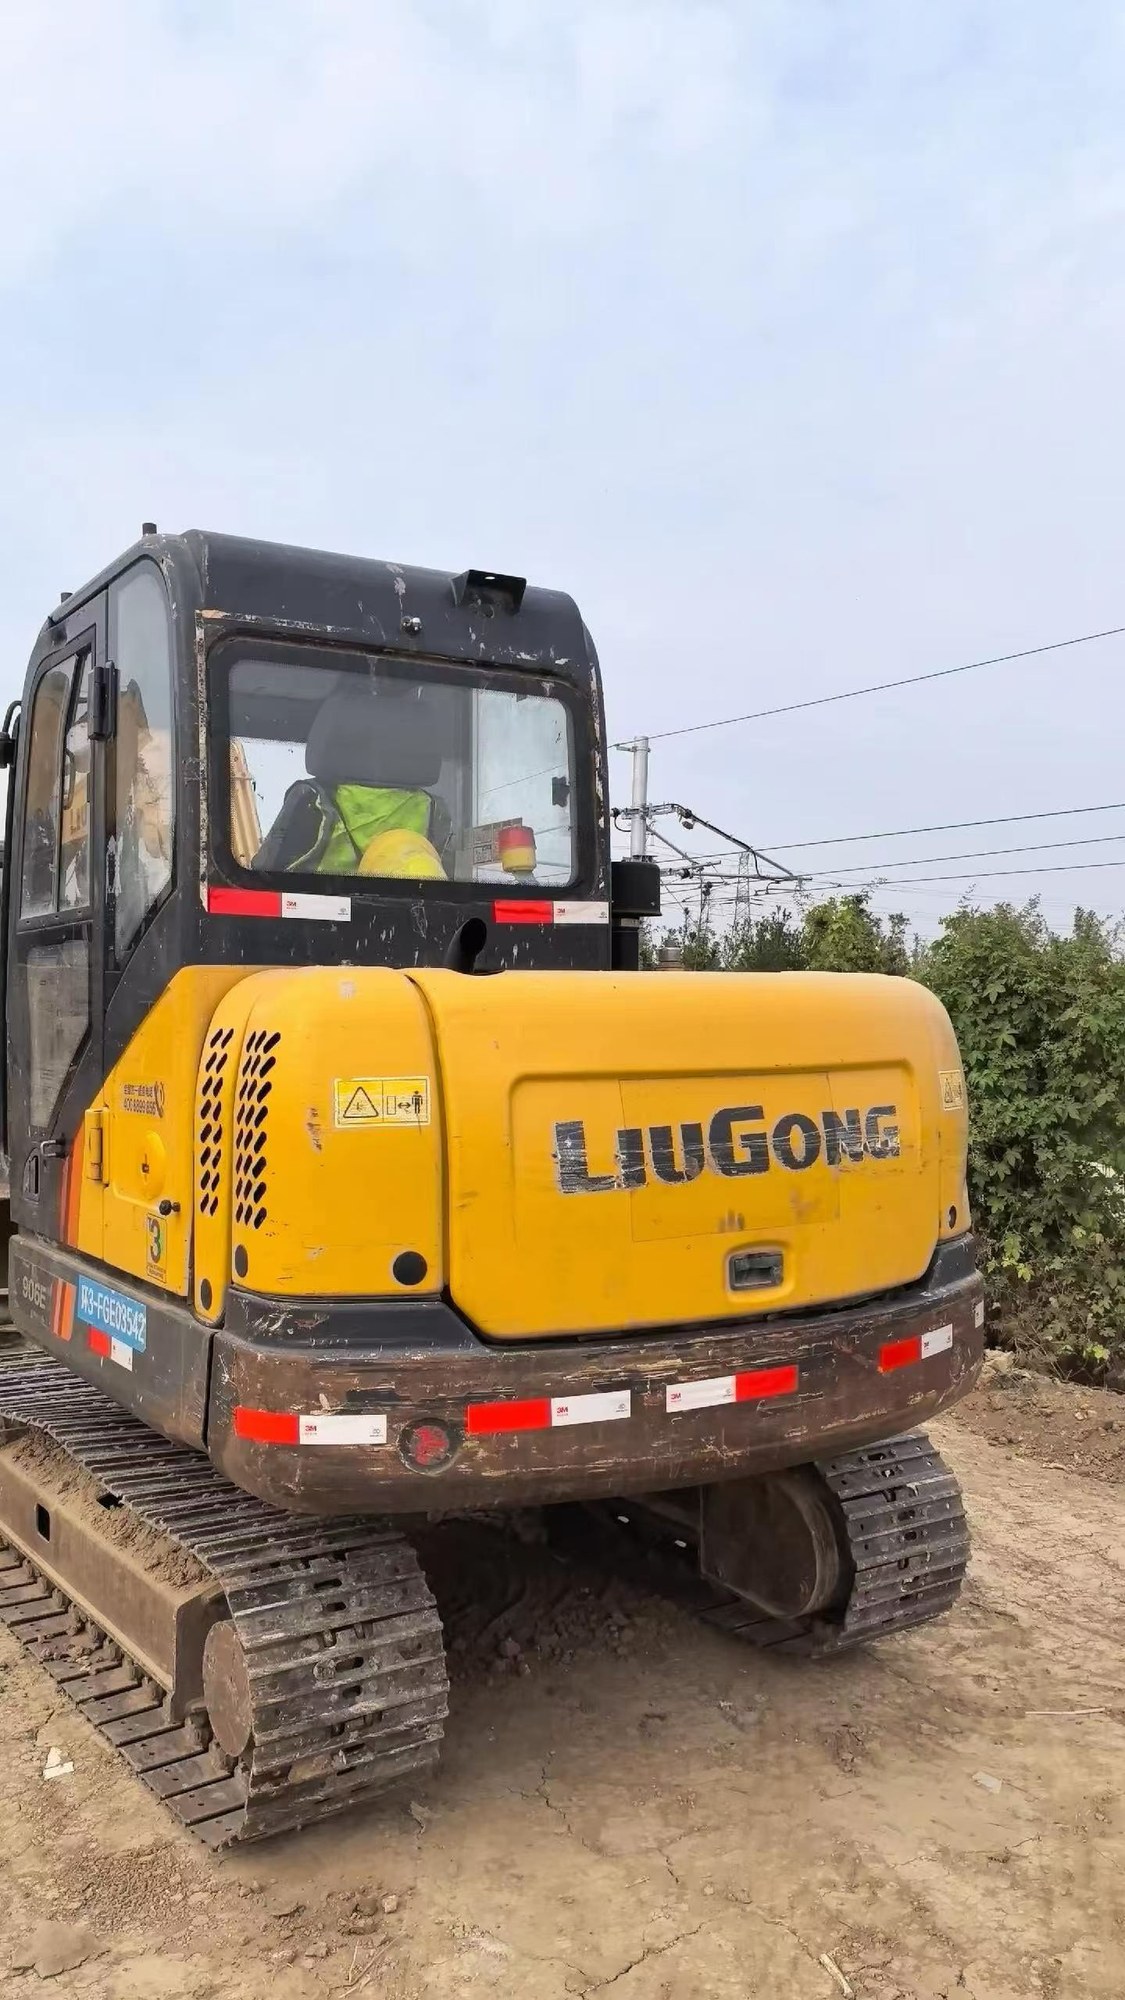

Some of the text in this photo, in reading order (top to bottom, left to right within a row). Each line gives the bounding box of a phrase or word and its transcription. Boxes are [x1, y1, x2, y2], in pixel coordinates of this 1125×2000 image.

[554, 1105, 901, 1194] LIUGONG
[148, 1217, 162, 1263] 3
[22, 1275, 46, 1310] 906E
